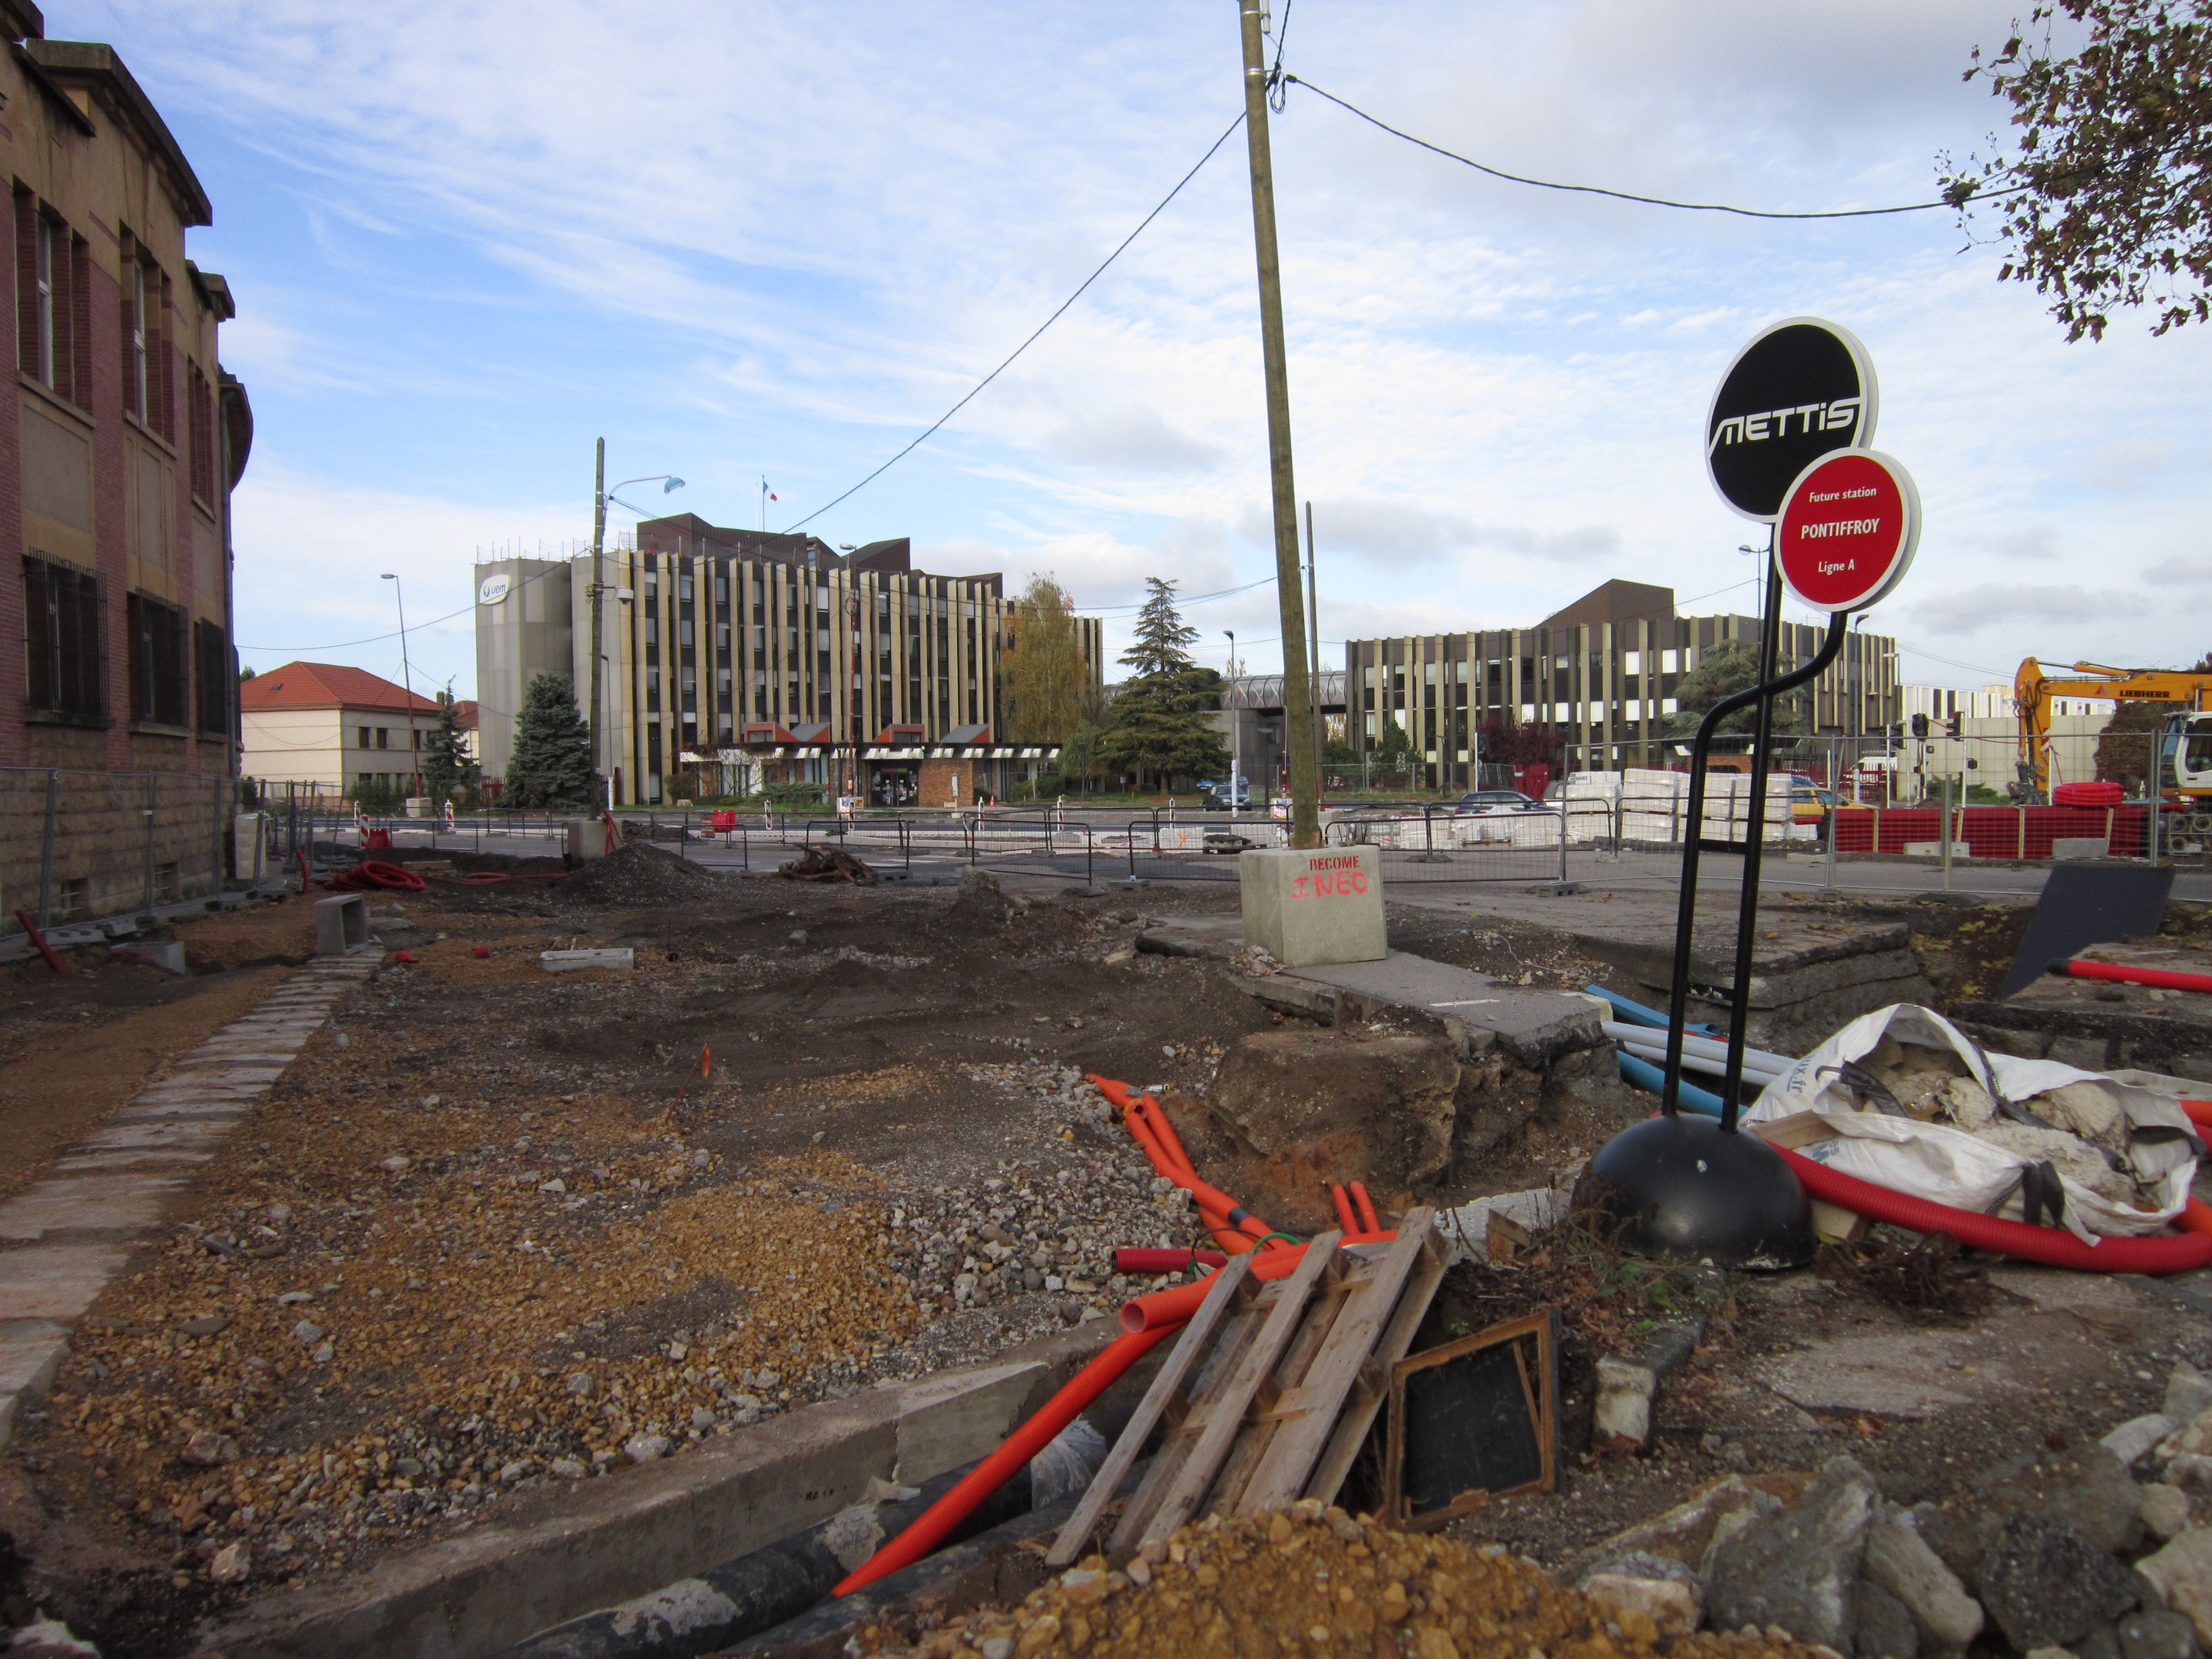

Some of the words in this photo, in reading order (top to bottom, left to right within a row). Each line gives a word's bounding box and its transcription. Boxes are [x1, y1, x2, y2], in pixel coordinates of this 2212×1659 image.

[1809, 492, 1839, 503] Future
[1842, 486, 1877, 499] station
[1801, 518, 1880, 539] PONTIFFROY
[1818, 561, 1845, 575] Ligne
[1848, 558, 1855, 571] A
[492, 584, 506, 594] uem
[2120, 690, 2170, 698] LIEBHERR
[1310, 856, 1359, 870] BECOME
[1291, 870, 1369, 898] INEO
